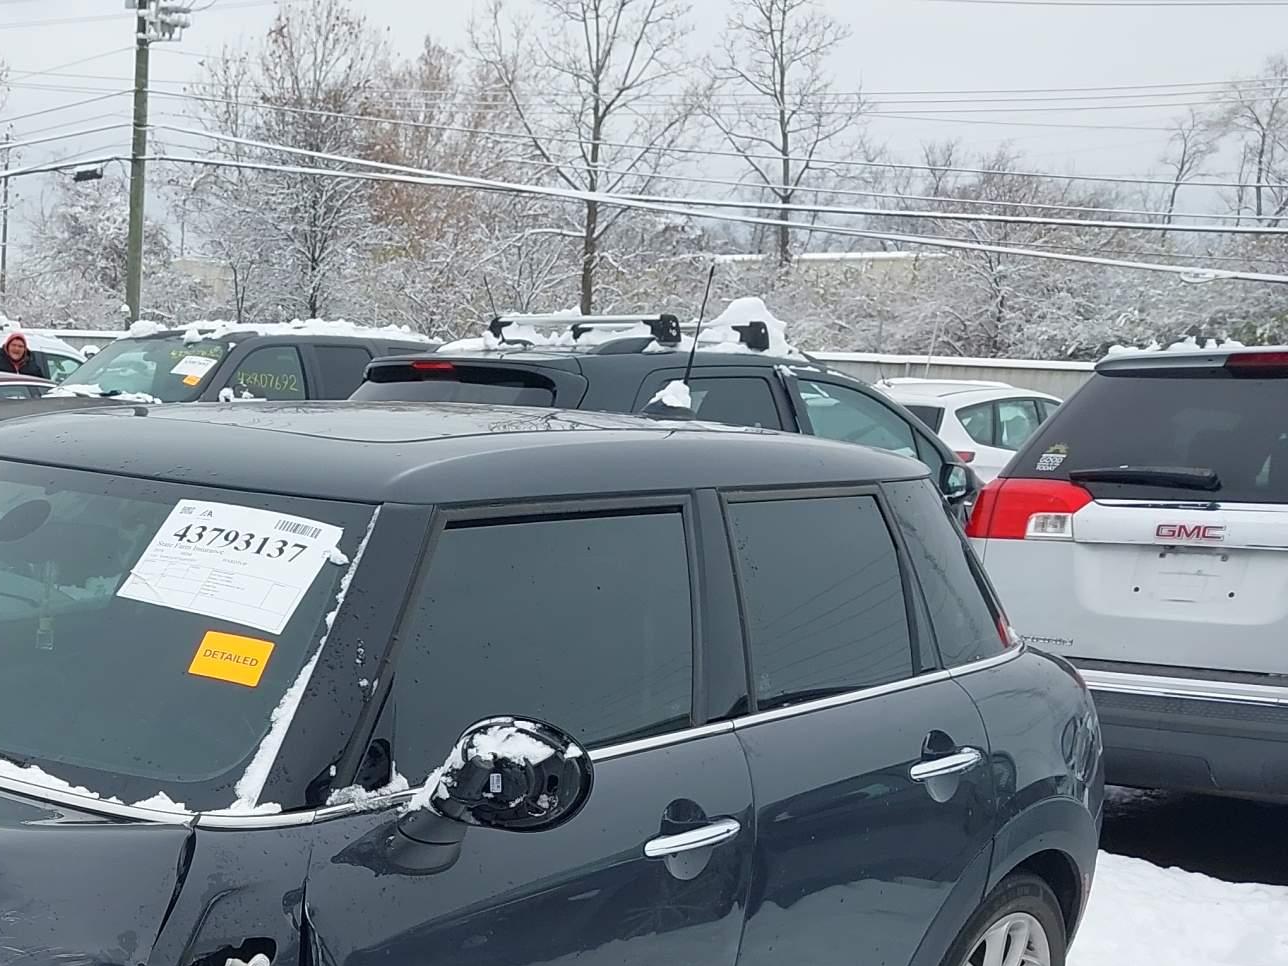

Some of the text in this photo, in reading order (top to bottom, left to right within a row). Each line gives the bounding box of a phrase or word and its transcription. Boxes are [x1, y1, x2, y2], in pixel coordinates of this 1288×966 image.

[1155, 523, 1226, 541] GMC
[173, 523, 308, 563] 43793137
[202, 648, 259, 667] DETAILED
